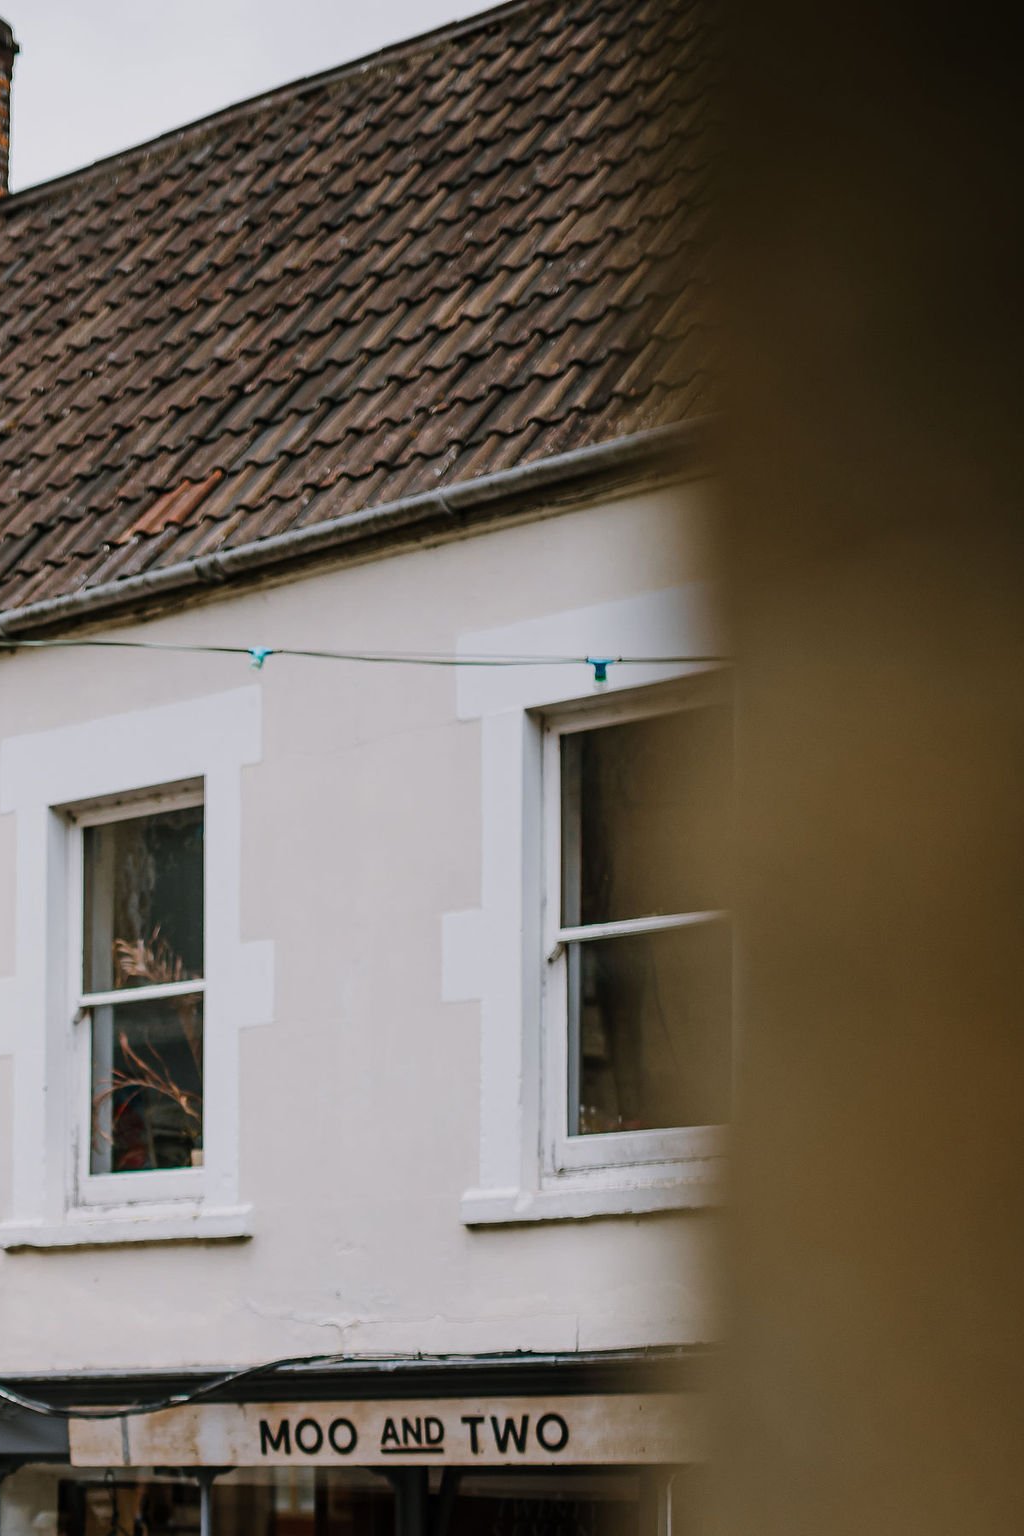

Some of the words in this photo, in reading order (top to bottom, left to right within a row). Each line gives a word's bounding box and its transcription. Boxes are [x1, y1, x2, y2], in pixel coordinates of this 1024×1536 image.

[259, 1417, 358, 1455] MOO
[380, 1416, 445, 1447] AND
[461, 1412, 570, 1455] TWO
